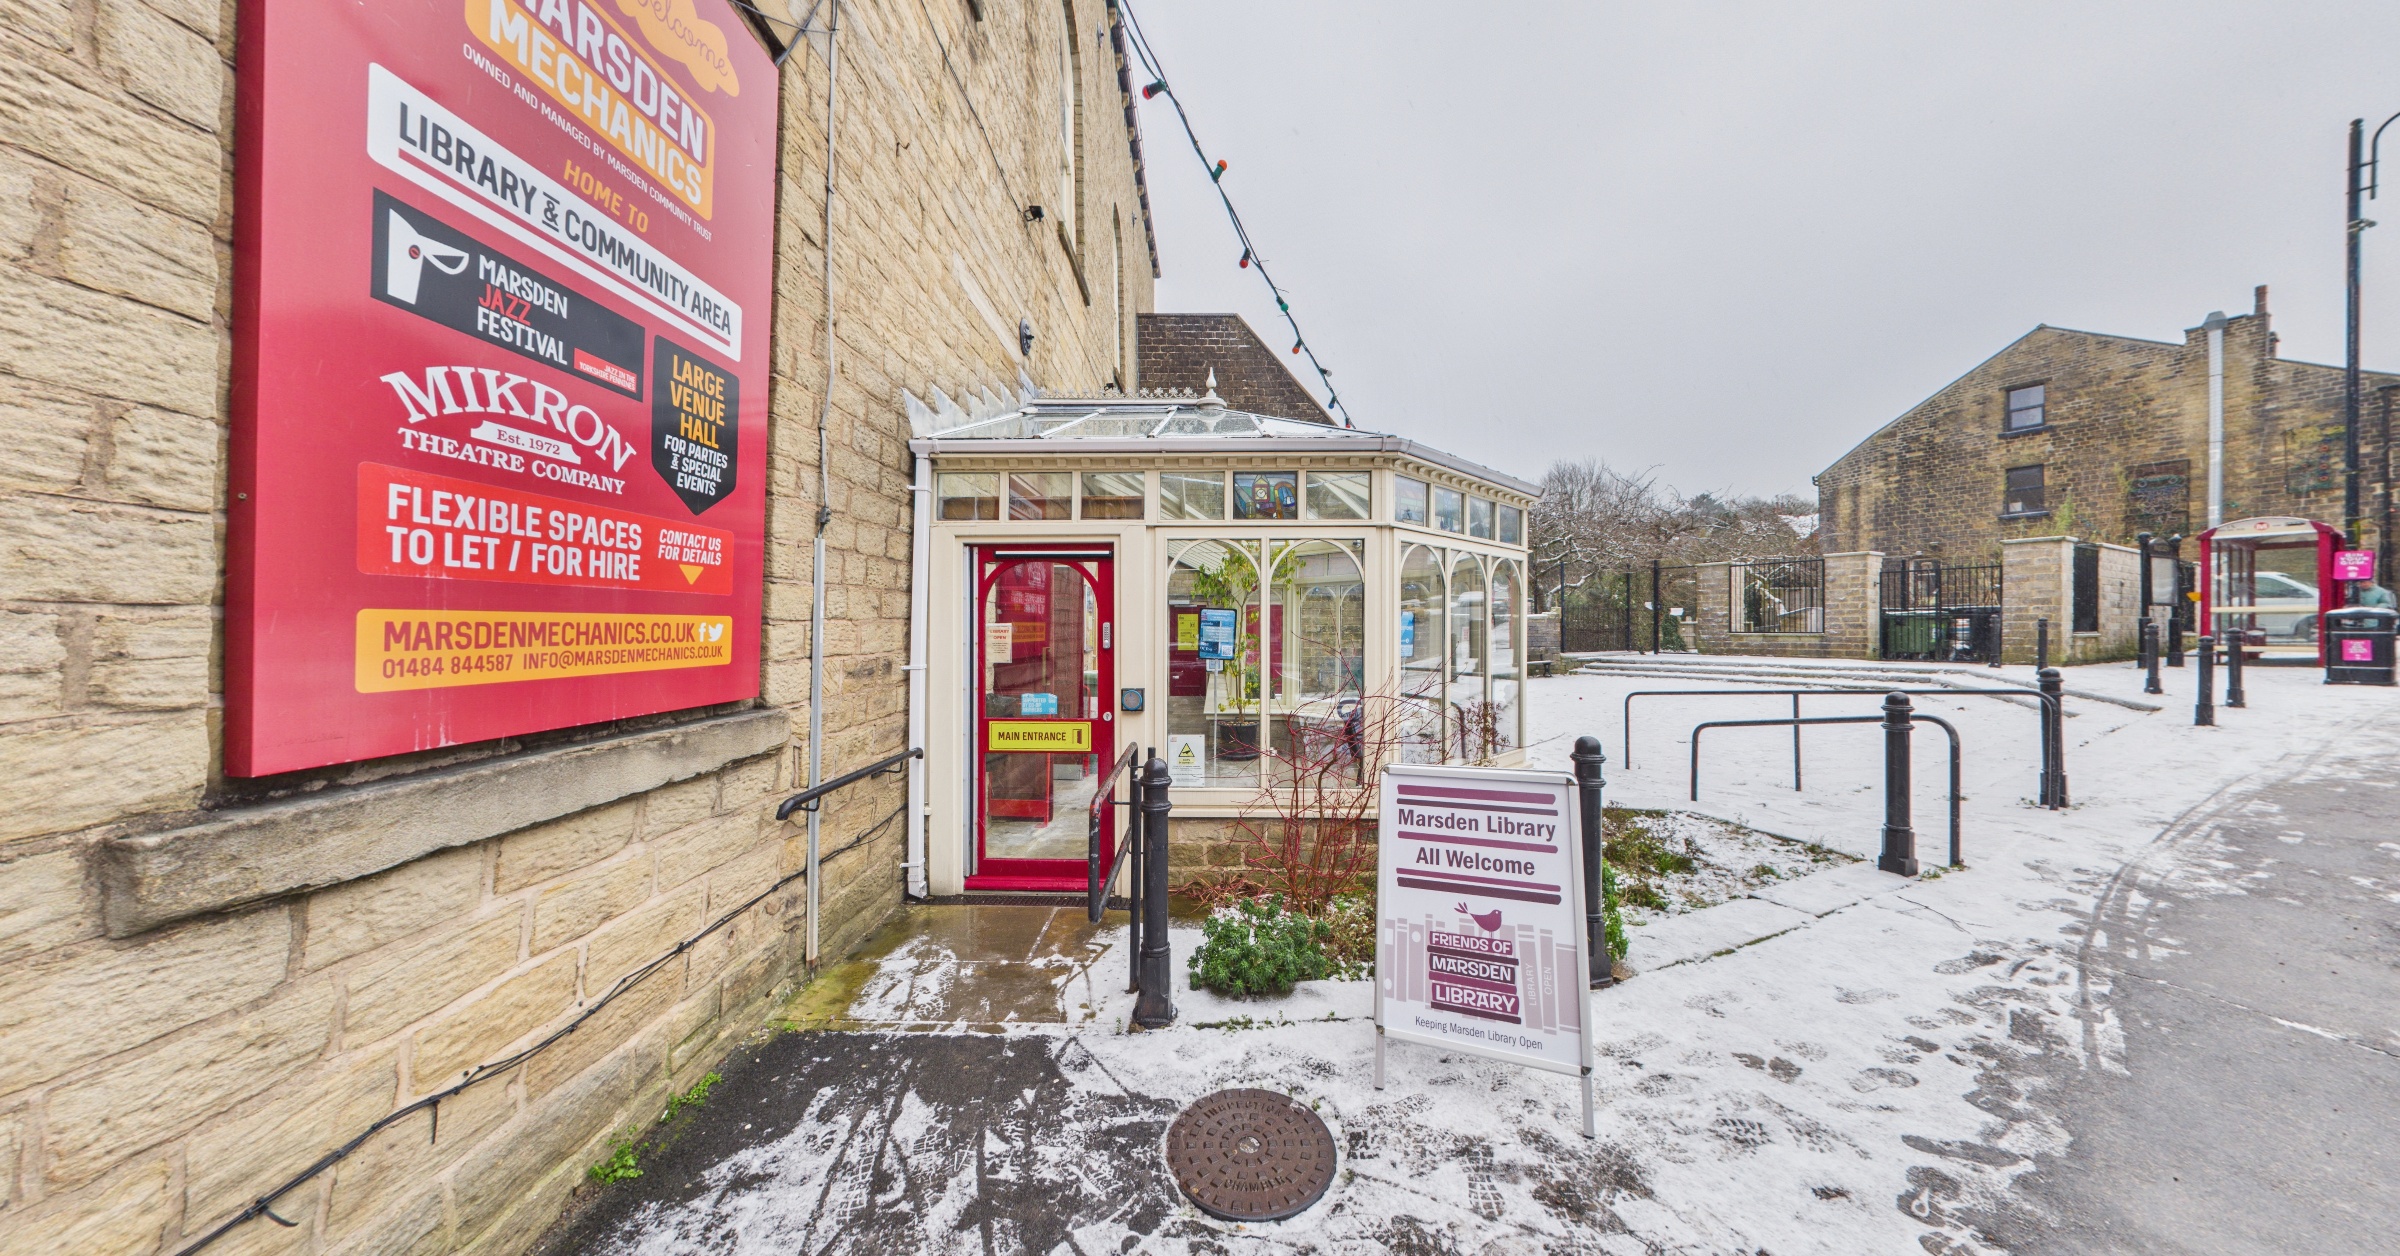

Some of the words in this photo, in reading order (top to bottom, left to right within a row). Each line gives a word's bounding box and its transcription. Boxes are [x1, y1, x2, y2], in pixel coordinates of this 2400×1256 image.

[636, 0, 728, 77] elcome
[490, 1, 702, 205] MECHANICS
[463, 43, 511, 89] OWNED
[514, 82, 538, 110] AND
[541, 102, 591, 149] MANAGED
[593, 142, 605, 160] BY
[607, 153, 648, 193] MARSDEN
[649, 186, 692, 226] COMMUNITY
[693, 220, 712, 242] TRUST
[563, 159, 623, 217] HOME
[628, 203, 649, 233] TO
[400, 101, 537, 215] LIBRARY
[542, 196, 560, 230] &
[565, 209, 689, 308] COMMUNITY
[690, 290, 731, 335] AREA
[479, 254, 568, 319] MARSDEN
[478, 283, 531, 326] JAZZ
[477, 305, 568, 365] FESTIVAL
[579, 361, 608, 380] YORKSHIRE
[609, 374, 636, 391] PENNINES
[604, 365, 618, 376] JAZZ
[619, 370, 626, 380] IN
[626, 373, 635, 384] THE
[672, 354, 725, 401] LARGE
[379, 365, 637, 473] MIKRON
[670, 380, 726, 426] VENUE
[497, 429, 525, 446] Est.
[529, 438, 561, 456] 1972
[680, 412, 719, 449] HALL
[397, 427, 525, 473] THEATRE
[532, 459, 626, 495] COMPANY
[664, 434, 687, 456] FOR
[688, 442, 728, 469] PARTIES
[671, 454, 680, 469] &
[681, 457, 722, 483] SPECIAL
[676, 471, 717, 496] EVENTS
[388, 483, 541, 538] FLEXIBLE
[548, 510, 643, 551] SPACES
[386, 525, 434, 565] TO
[444, 532, 500, 570] LET
[531, 543, 582, 577] FOR
[588, 550, 641, 581] HIRE
[658, 544, 680, 561] FOR
[682, 548, 722, 566] DETAILS
[659, 528, 706, 549] CONTACT
[708, 537, 722, 551] US
[384, 621, 696, 652] MARSDENMECHANICS.CO.UK
[382, 658, 444, 679] 01484
[451, 654, 513, 675] 844587
[523, 645, 723, 670] INFO@MARSDENMECHANICS.CO.UK
[998, 731, 1020, 741] MAIN
[1022, 731, 1067, 741] ENTRANCE
[1398, 809, 1479, 832] Marsden
[1487, 815, 1556, 842] Library
[1416, 847, 1441, 866] All
[1445, 849, 1536, 876] Welcome
[1431, 933, 1489, 952] FRIENDS
[1491, 939, 1513, 955] OF
[1432, 955, 1512, 982] MARSDEN
[1525, 963, 1537, 1006] LIBRARY
[1543, 966, 1553, 995] OPEN
[1436, 983, 1516, 1014] LIBRARY
[1415, 1015, 1448, 1034] Keeping
[1449, 1021, 1485, 1039] Marsden
[1487, 1028, 1517, 1047] Library
[1519, 1035, 1543, 1050] Open
